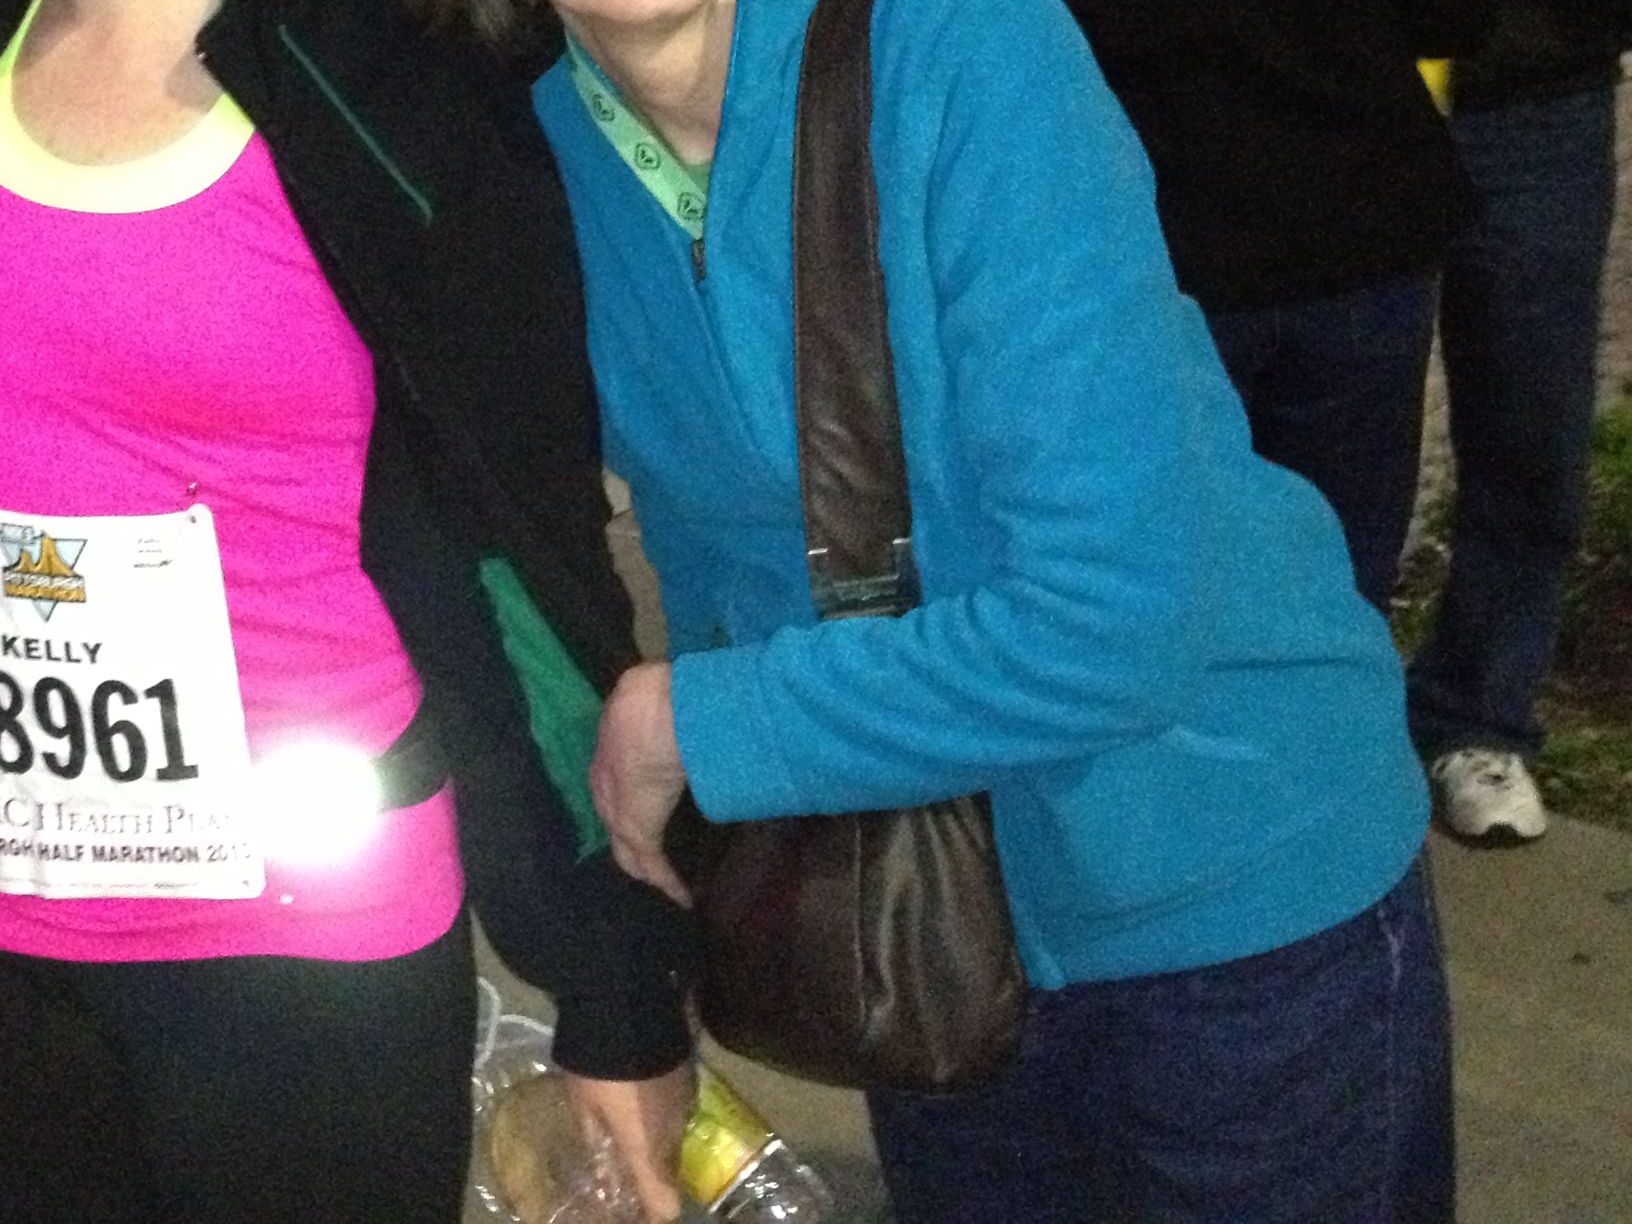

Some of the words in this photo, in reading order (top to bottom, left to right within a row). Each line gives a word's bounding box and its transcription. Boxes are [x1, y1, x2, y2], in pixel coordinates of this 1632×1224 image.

[1, 634, 102, 664] KELLY
[34, 802, 153, 834] HEALTH
[38, 842, 84, 861] HALF
[91, 844, 200, 863] MARATHON
